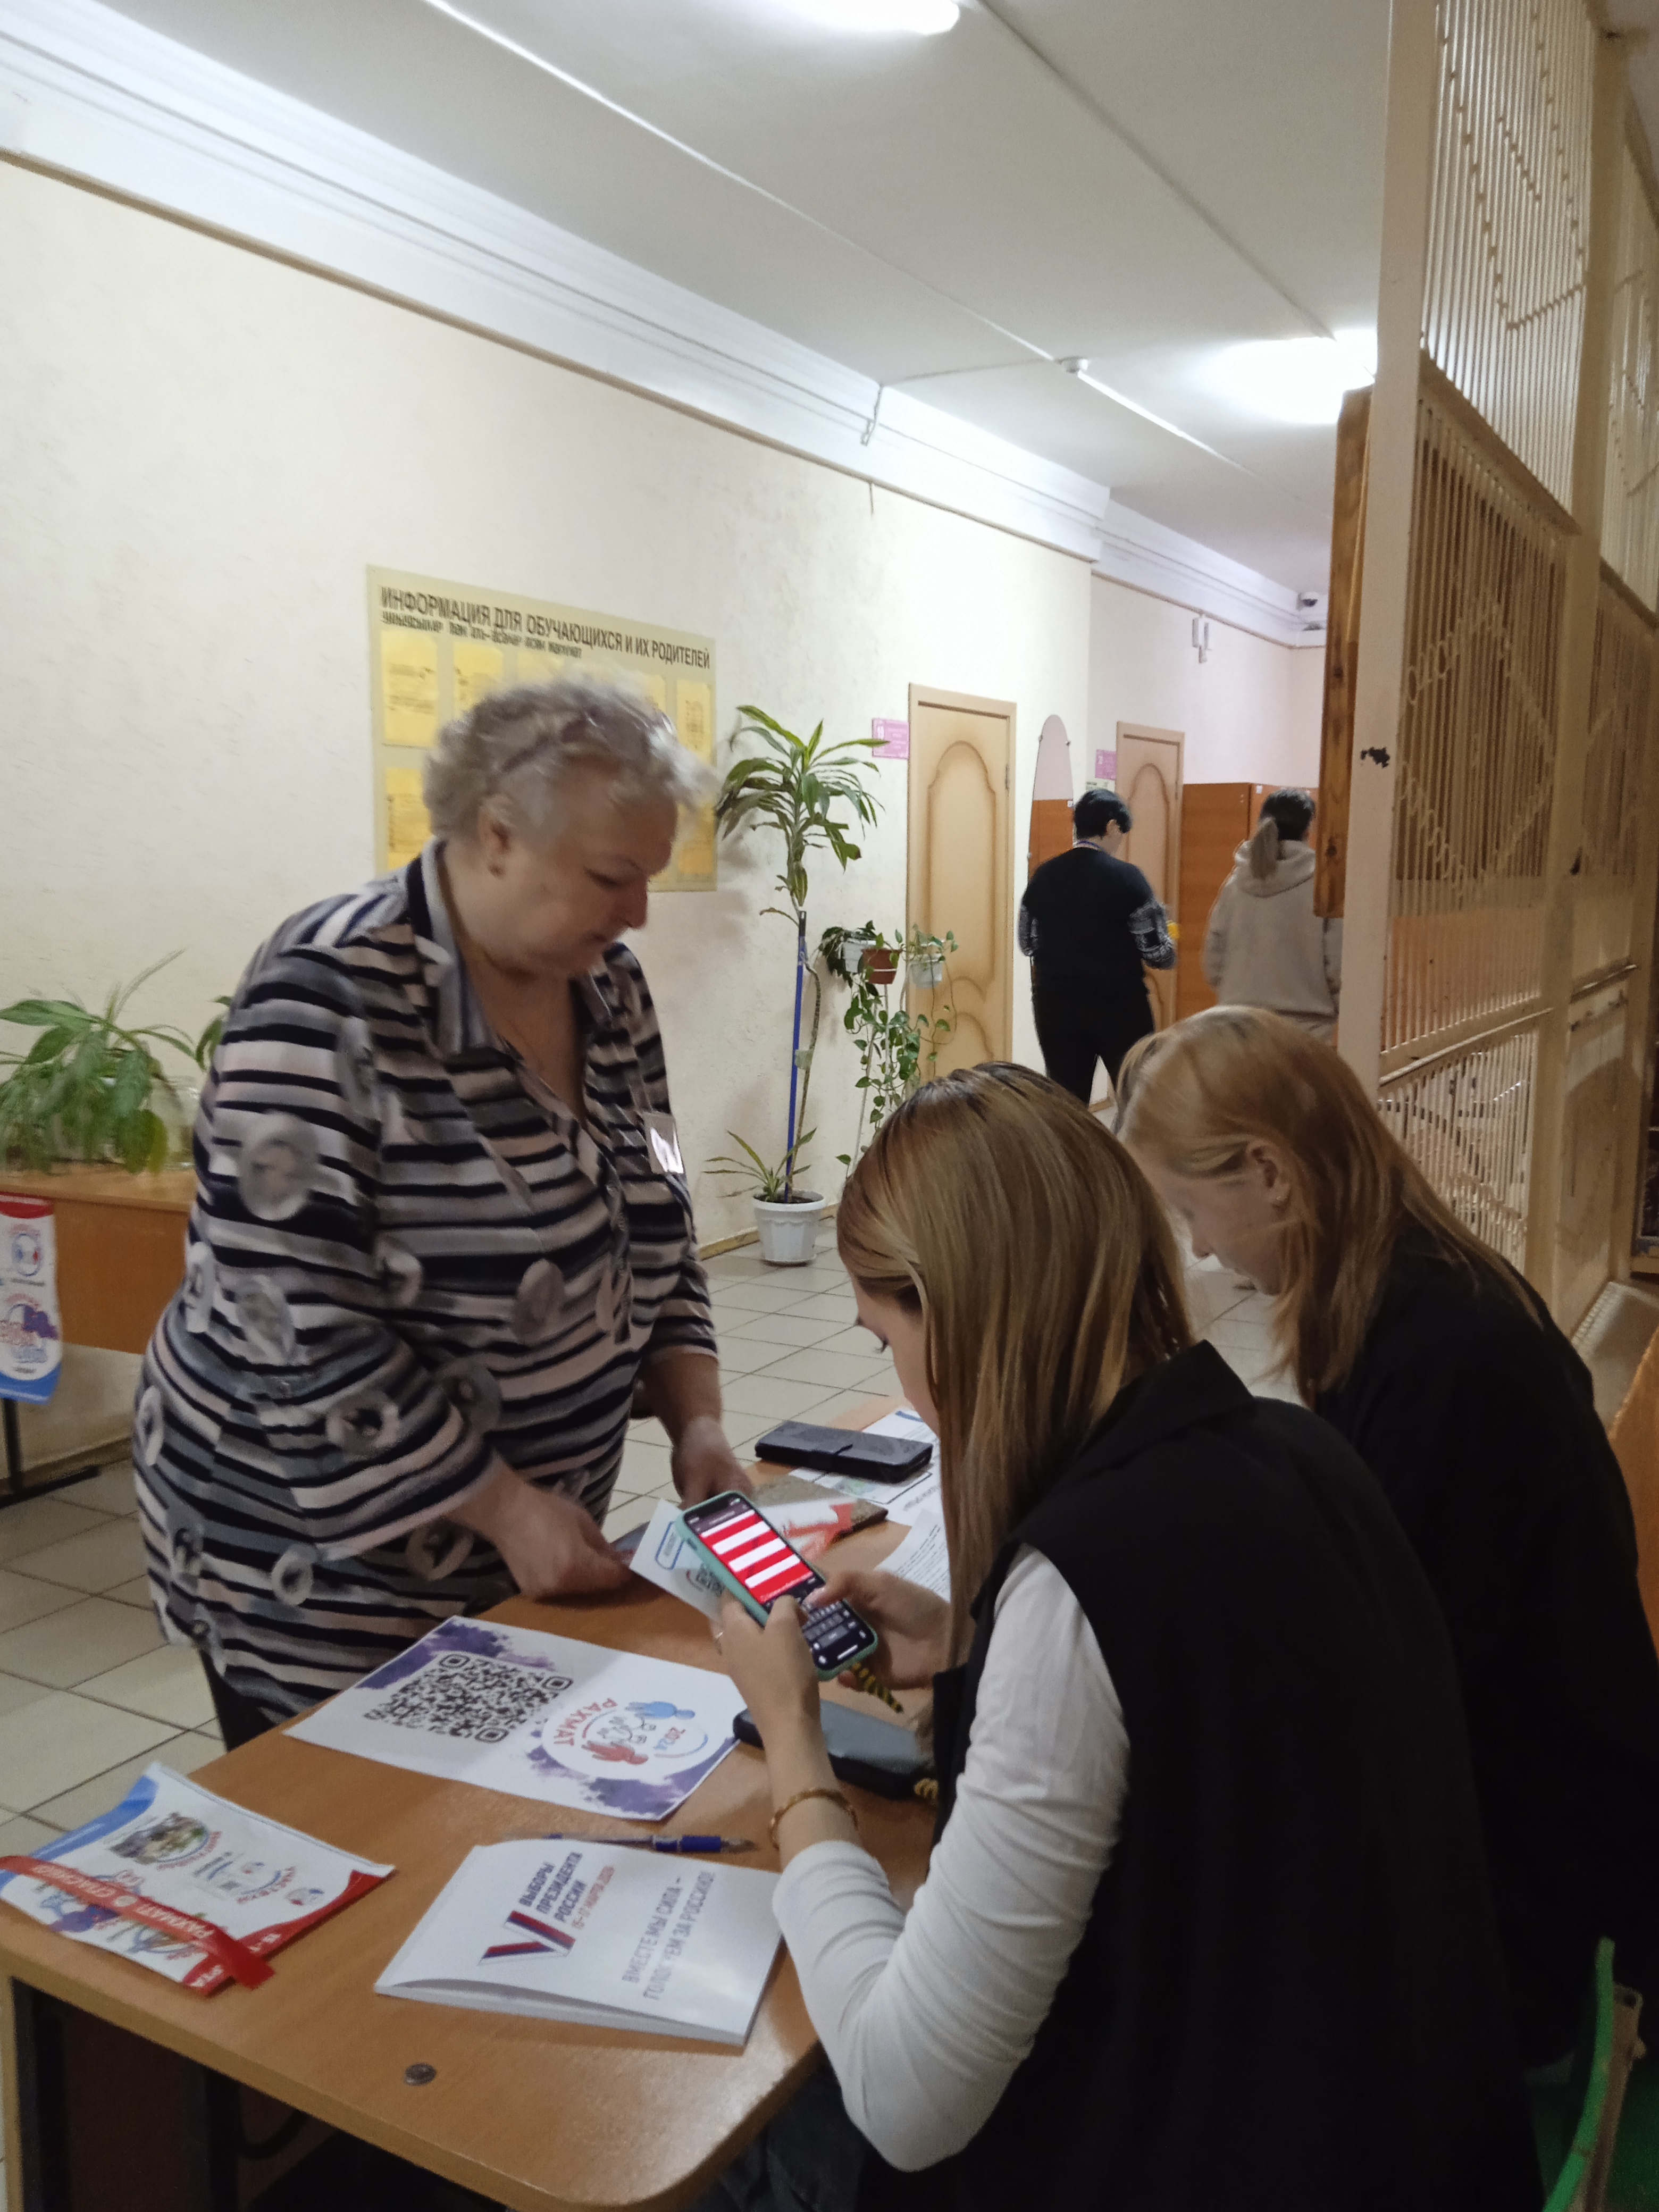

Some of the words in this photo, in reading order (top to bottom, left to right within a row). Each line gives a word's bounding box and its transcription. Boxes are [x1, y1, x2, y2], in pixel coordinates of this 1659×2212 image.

[381, 586, 491, 627] ИНФОРМАЦИЯ
[493, 607, 522, 632] ДЛЯ
[526, 613, 623, 652] ОБУЧАЮЩИХСЯ
[625, 635, 633, 654] И
[635, 636, 649, 658] ИХ
[652, 639, 710, 669] РОДИТЕЛЕЙ
[518, 1861, 555, 1907] ВЫБОРЫ
[554, 1879, 586, 1923] РОССИИ
[644, 1915, 668, 1937] МЫ
[672, 1922, 692, 1938] ЗА
